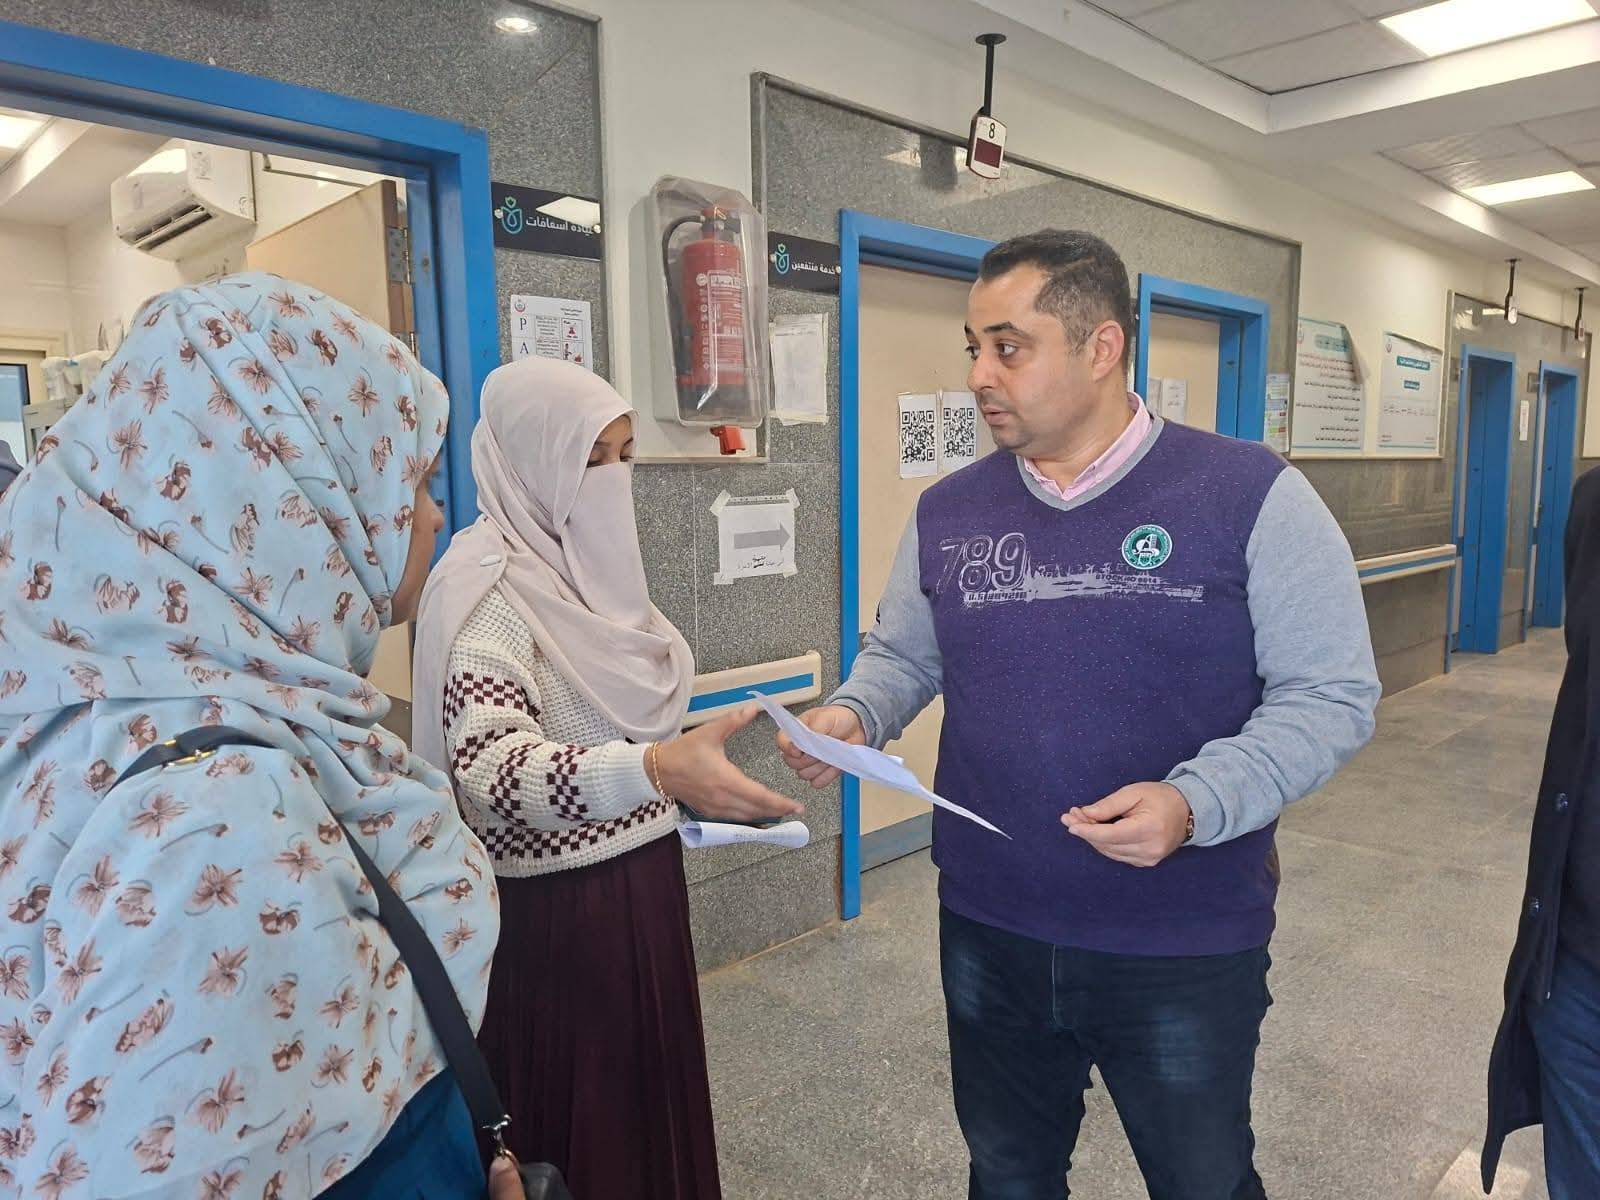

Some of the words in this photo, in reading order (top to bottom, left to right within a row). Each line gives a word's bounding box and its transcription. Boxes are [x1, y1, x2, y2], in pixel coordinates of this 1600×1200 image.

[988, 122, 996, 139] 8
[526, 216, 568, 230] اسعافات
[791, 261, 818, 272] منتفعين
[519, 317, 527, 331] P
[519, 341, 529, 355] A
[936, 532, 1030, 594] 789
